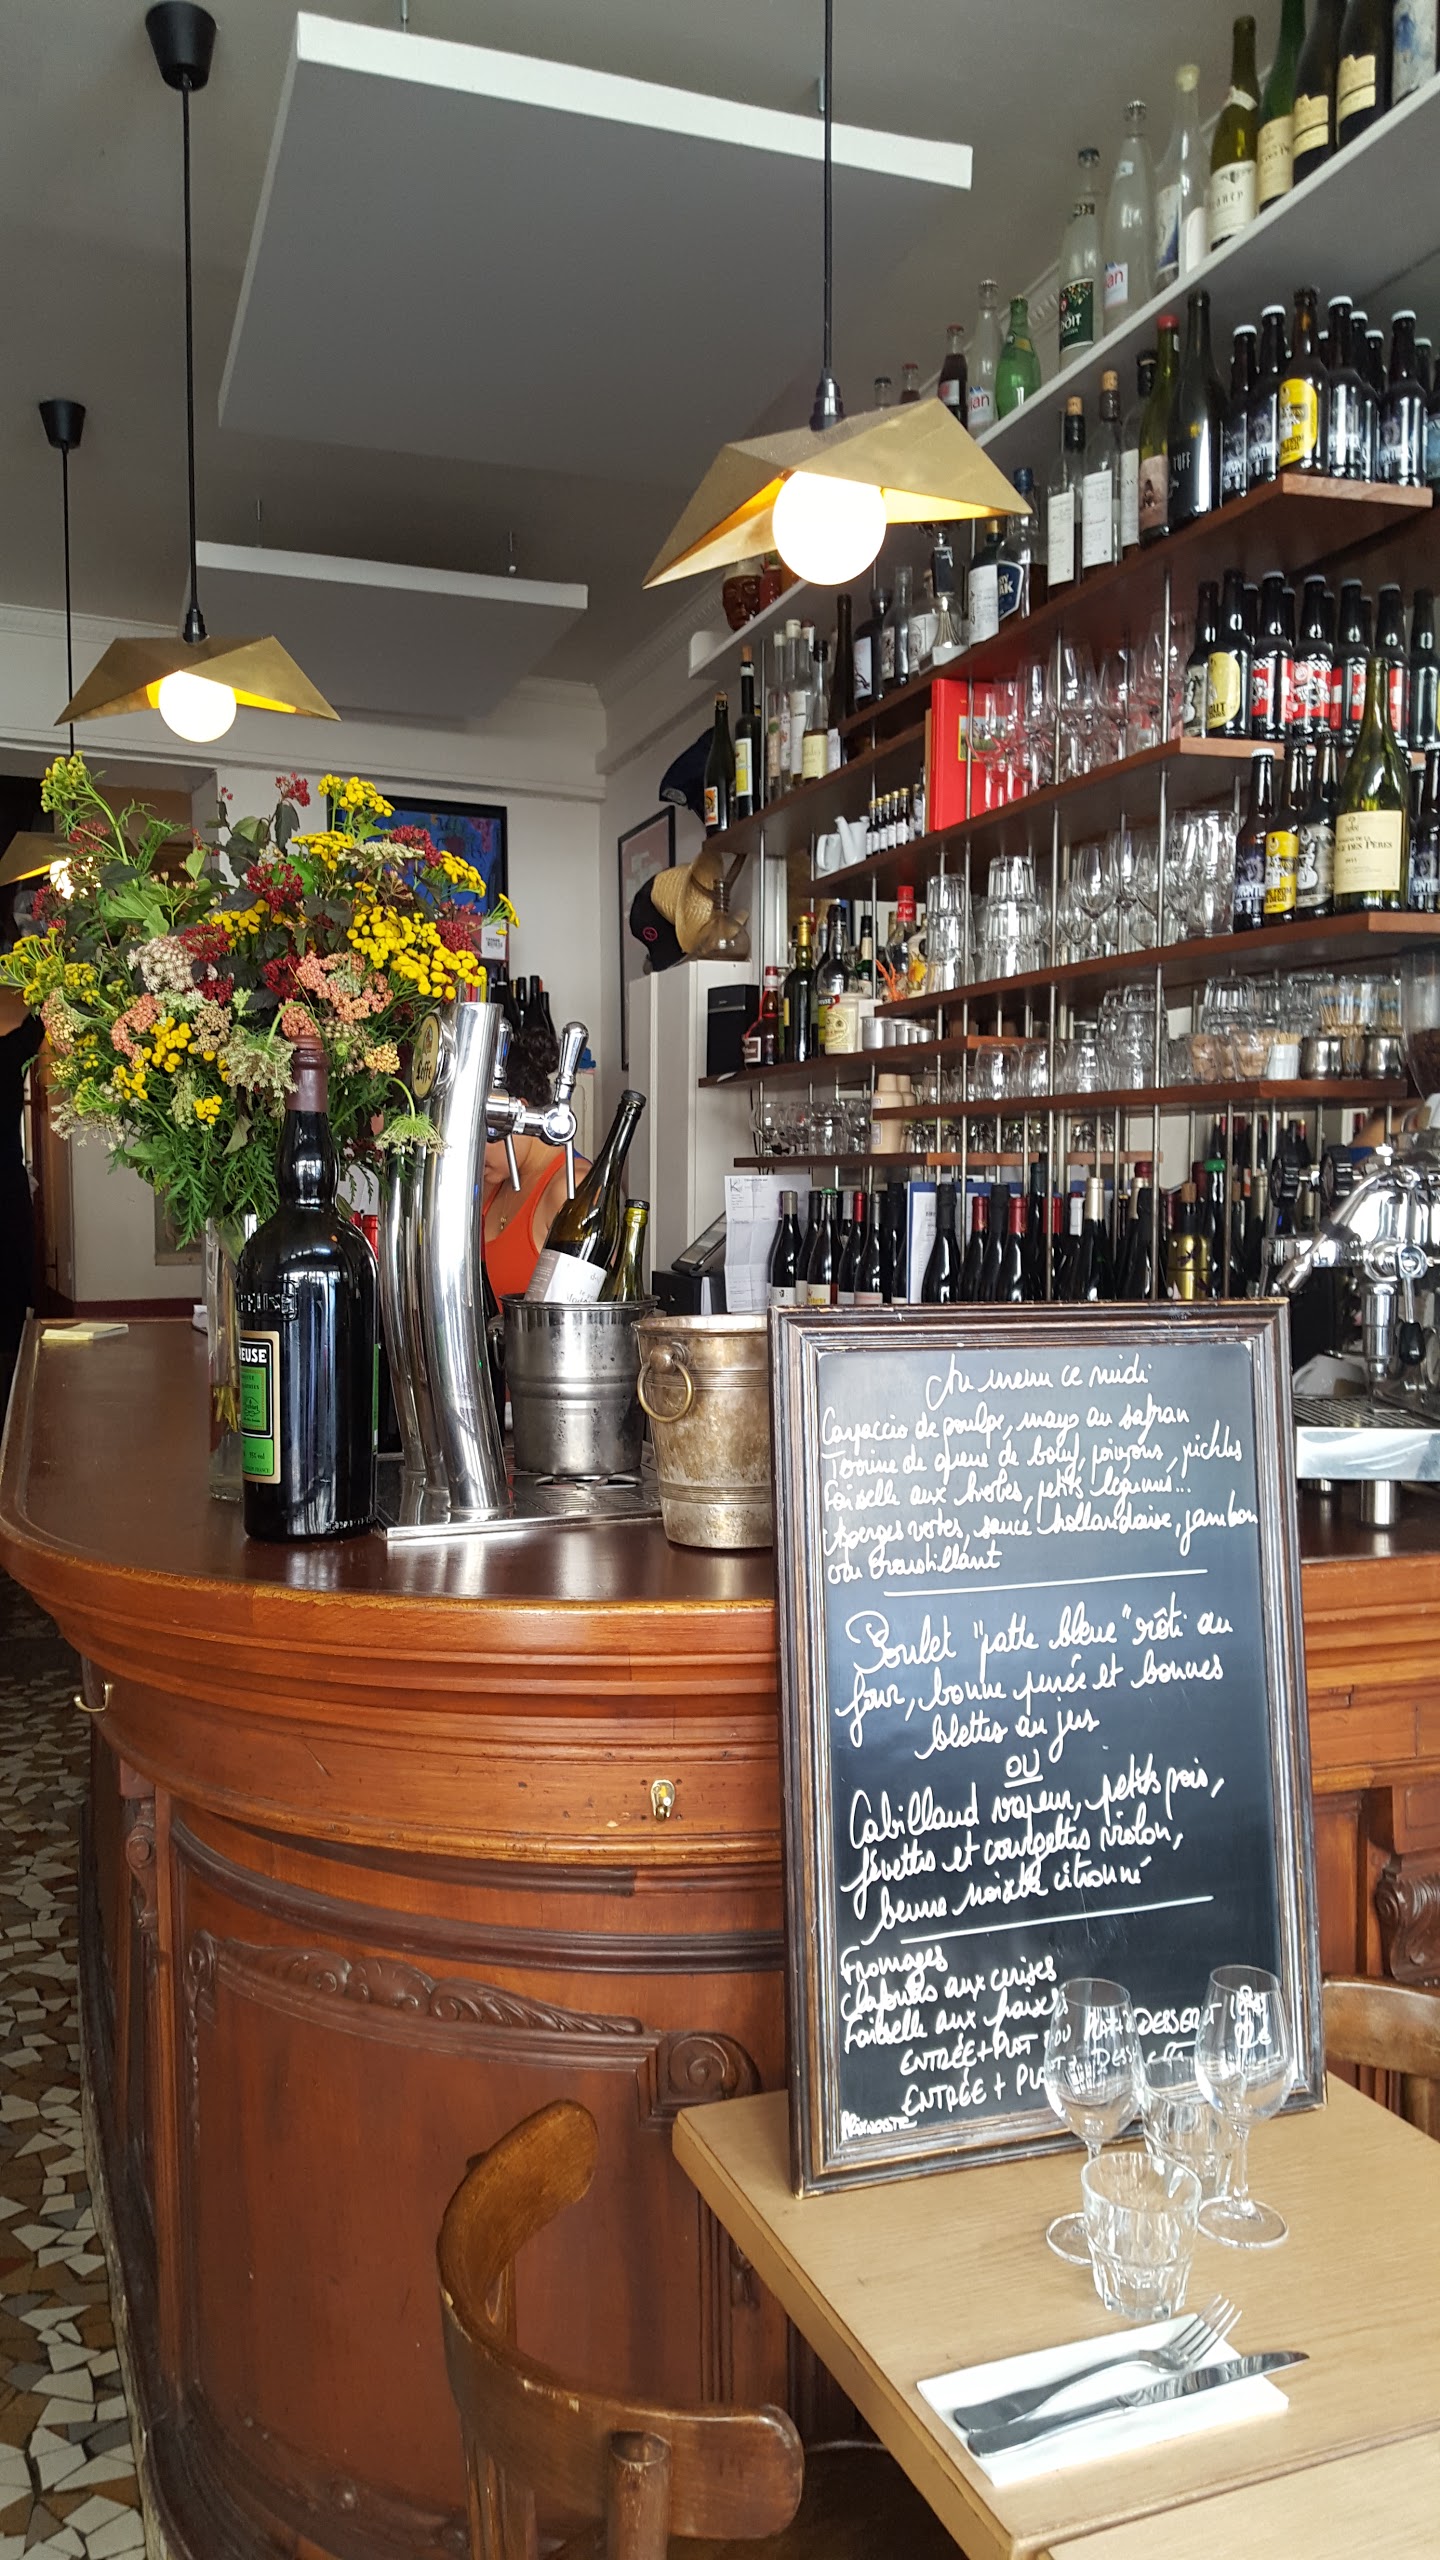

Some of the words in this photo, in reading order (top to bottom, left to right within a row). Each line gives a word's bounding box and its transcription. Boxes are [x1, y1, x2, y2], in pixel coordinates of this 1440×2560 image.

[978, 1368, 1053, 1393] menu
[1061, 1364, 1083, 1388] ce
[1089, 1353, 1152, 1388] midi
[821, 1406, 909, 1456] Carpaccio
[915, 1411, 940, 1440] de
[943, 1401, 1013, 1452] poulpe,
[1015, 1410, 1079, 1446] mayo
[1086, 1406, 1113, 1427] au
[1118, 1393, 1189, 1445] safran
[822, 1449, 898, 1480] Terrine
[902, 1443, 927, 1474] de
[934, 1451, 989, 1485] queue
[998, 1440, 1019, 1467] de
[1181, 1419, 1242, 1479] pickles
[823, 1516, 904, 1560] Asperges
[974, 1515, 1032, 1540] sauce
[1180, 1489, 1258, 1556] jambon
[910, 1485, 946, 1506] aux
[1036, 1468, 1084, 1524] petits
[845, 1611, 957, 1674] Poulet
[1197, 1611, 1234, 1636] au
[918, 1667, 1006, 1711] bonne
[1013, 1653, 1087, 1716] purée
[1092, 1652, 1123, 1689] et
[1130, 1649, 1224, 1688] bonnes
[914, 1710, 1008, 1759] blettes
[1015, 1715, 1047, 1738] au
[1049, 1696, 1100, 1763] jus
[850, 1781, 979, 1849] Cabillaud
[1085, 1753, 1161, 1826] petits
[942, 1831, 980, 1872] et
[984, 1814, 1090, 1877] courgettes
[1101, 1801, 1183, 1851] violon,
[861, 1886, 947, 1945] beurre
[1054, 1852, 1152, 1891] citronné
[841, 1945, 948, 1990] Fromages
[945, 1974, 986, 2002] aux
[990, 1956, 1057, 1988] cerises
[936, 2009, 976, 2034] aux
[901, 2067, 987, 2117] ENTRÉE
